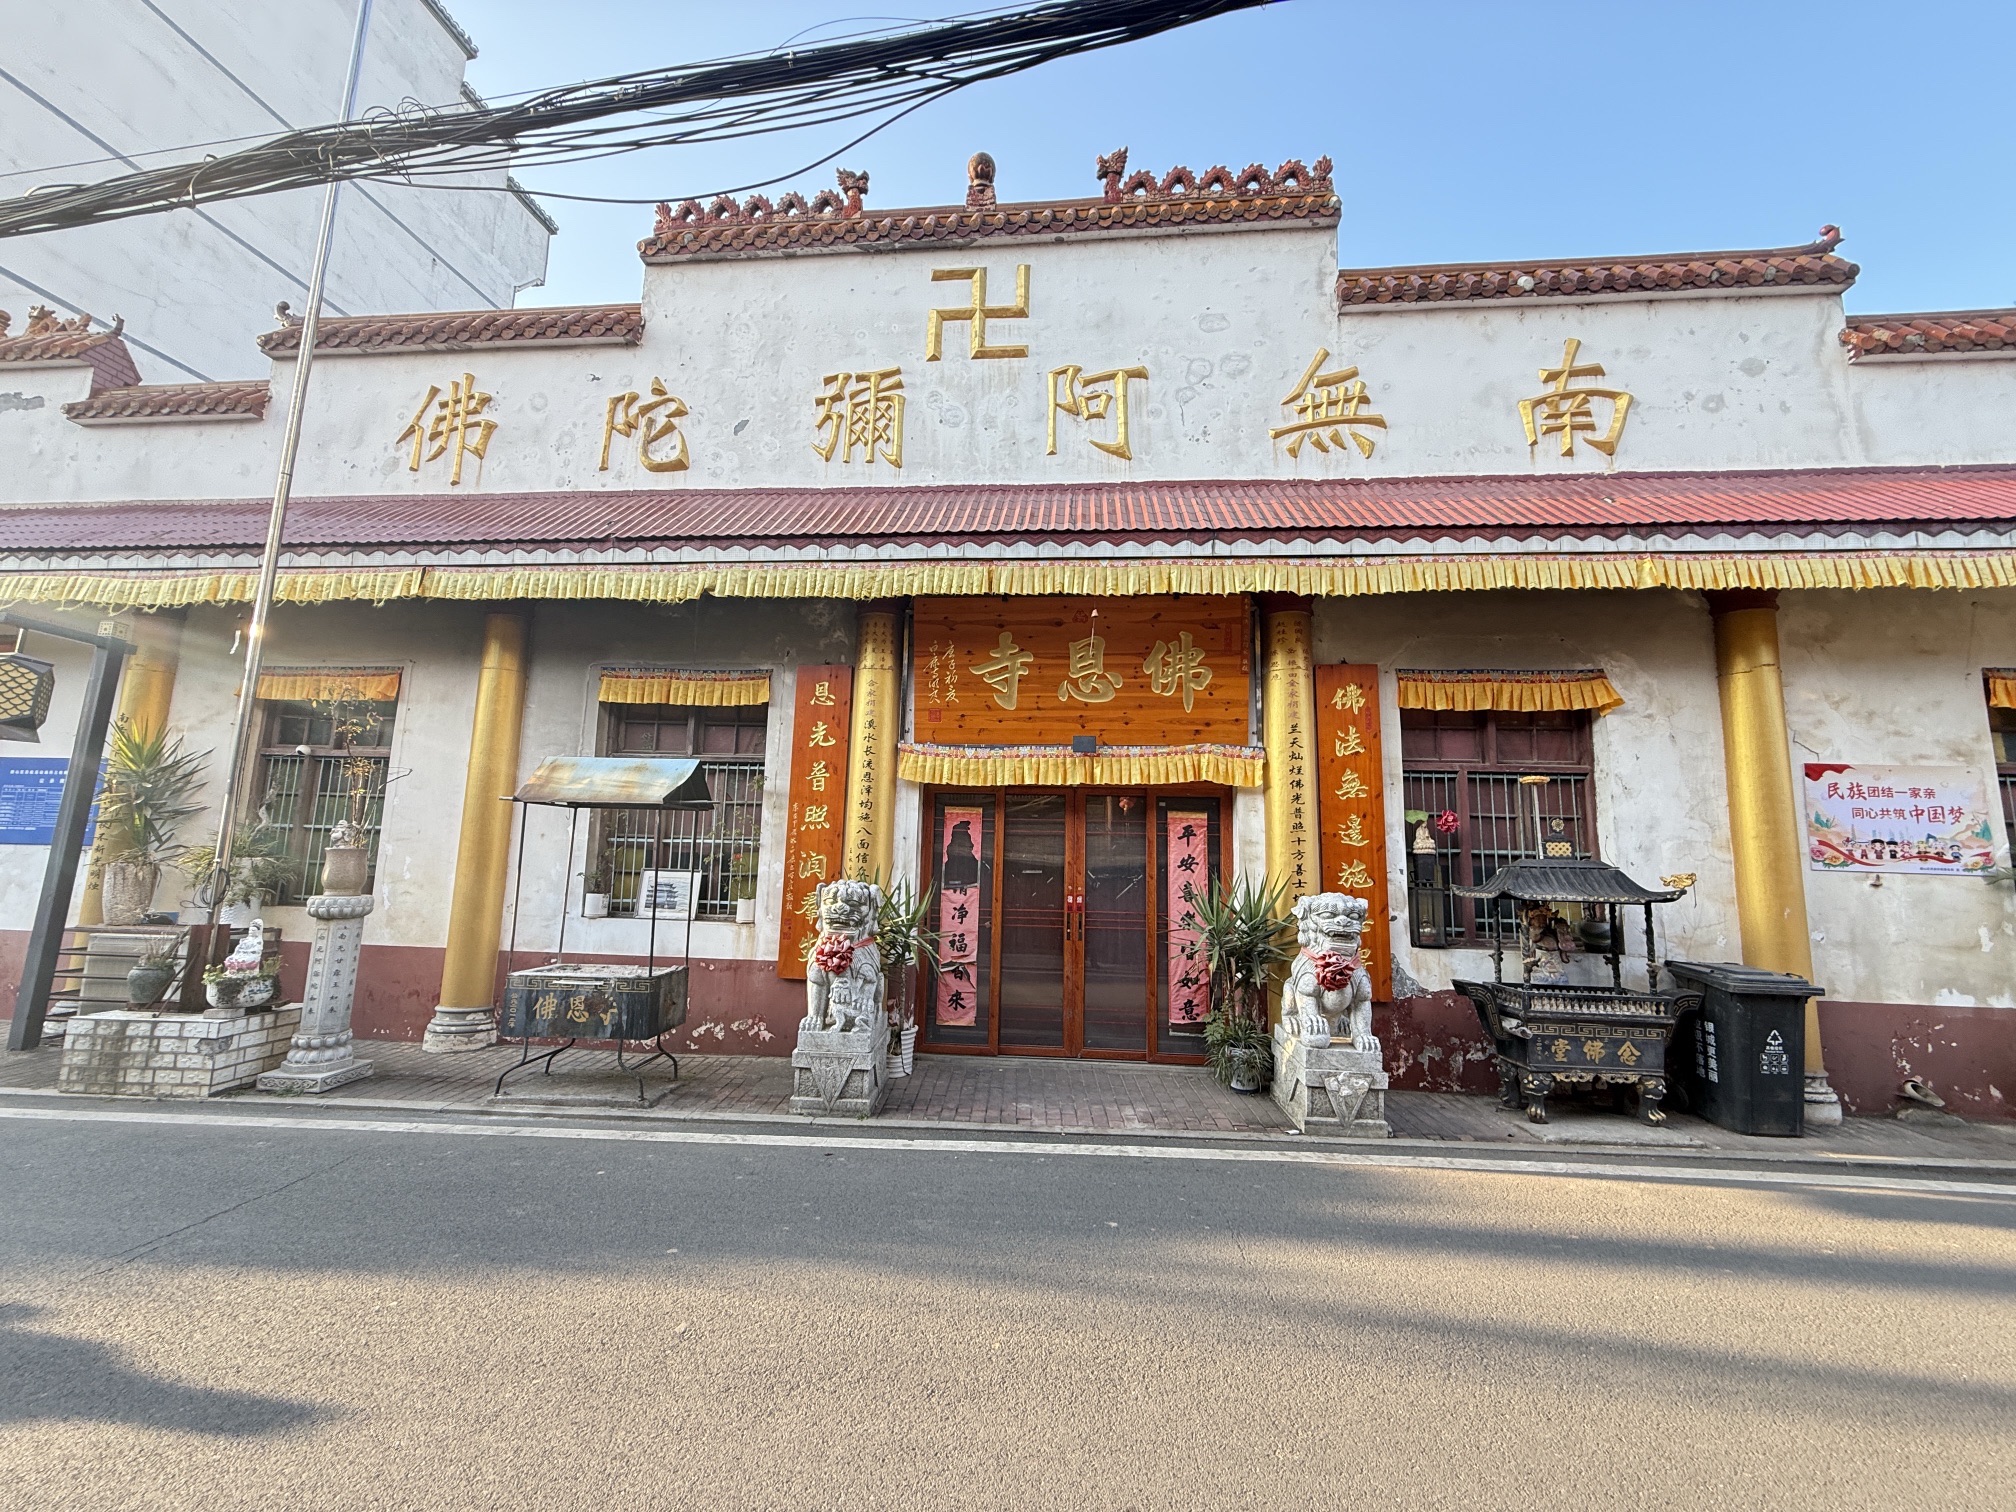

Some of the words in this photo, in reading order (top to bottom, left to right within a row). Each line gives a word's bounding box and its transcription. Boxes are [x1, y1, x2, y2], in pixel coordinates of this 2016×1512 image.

[1827, 781, 1937, 802] 民族团结一家亲
[1331, 683, 1376, 970] 佛法無邊施
[1851, 804, 1966, 826] 同心共筑中国梦
[1551, 1038, 1642, 1066] 念佛堂
[1704, 1020, 1719, 1084] 银城更美丽
